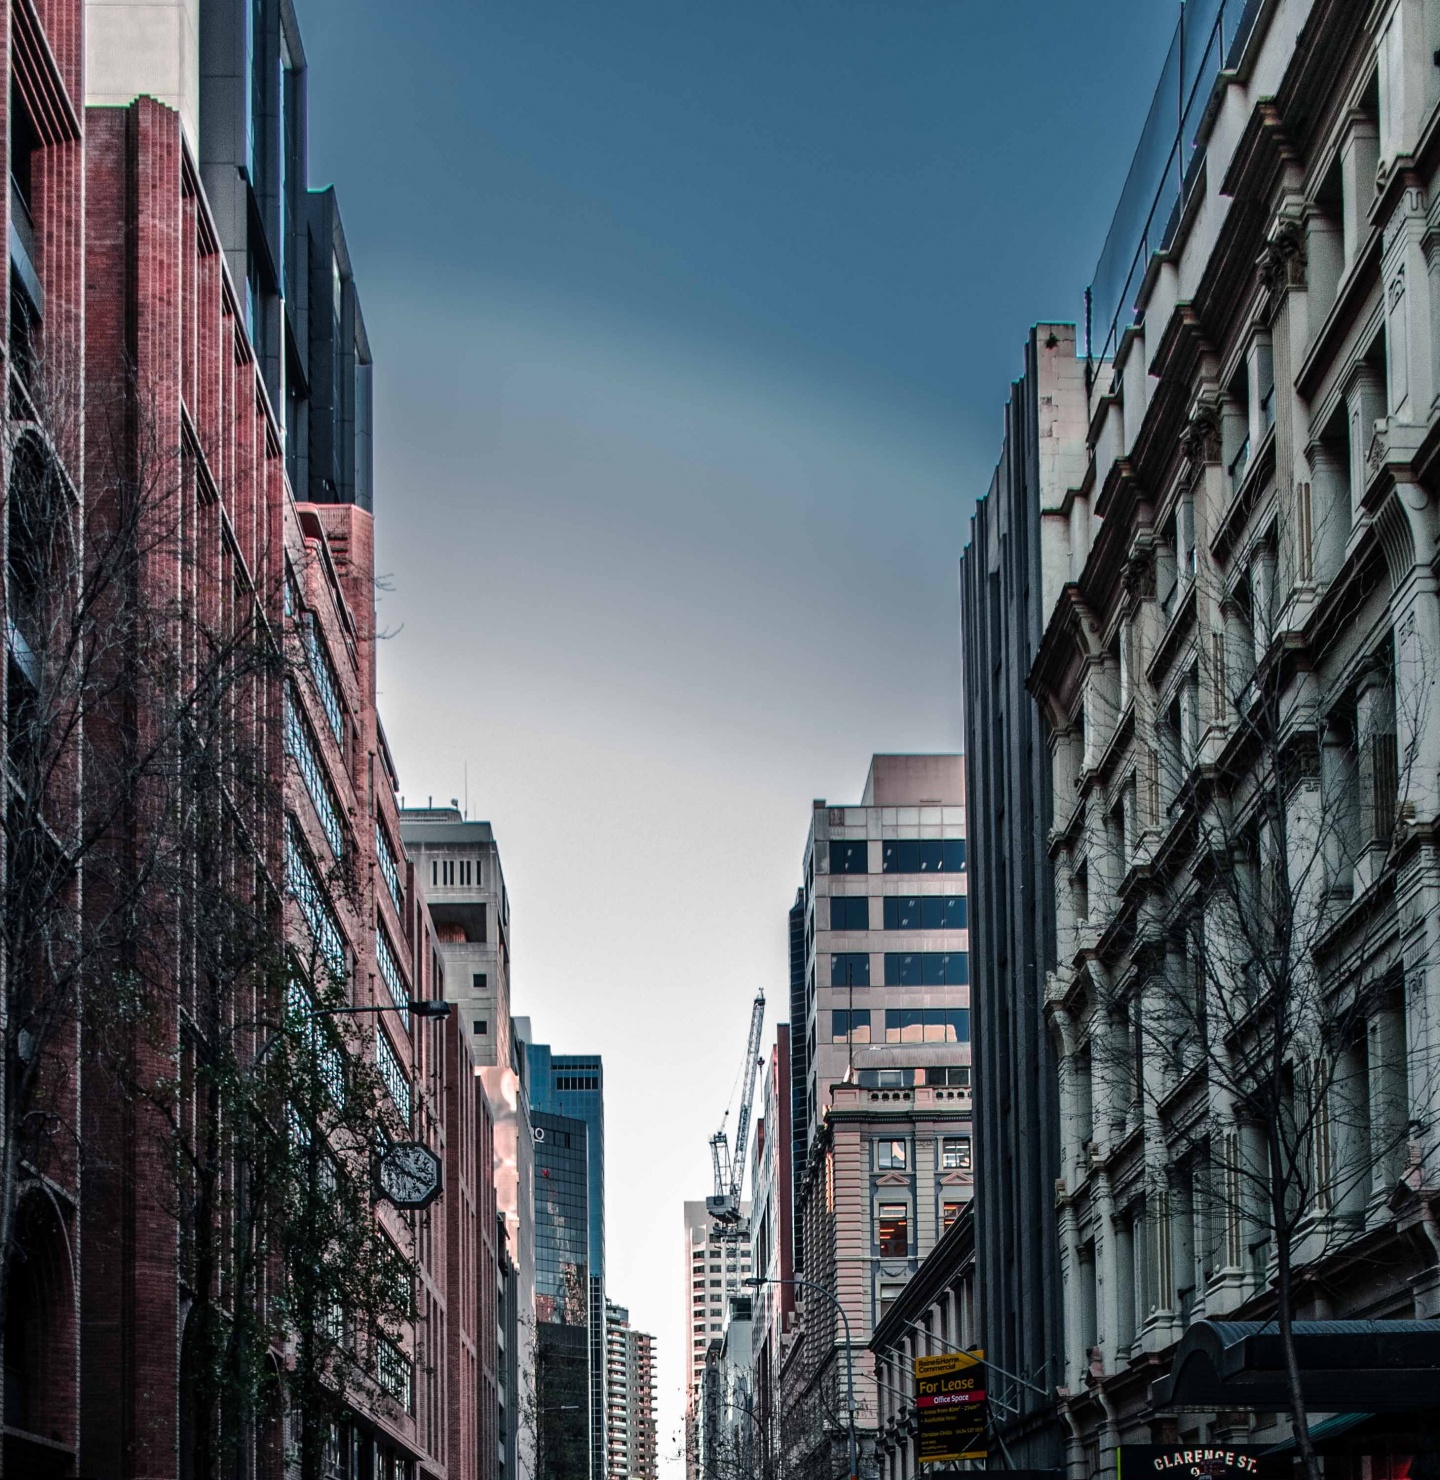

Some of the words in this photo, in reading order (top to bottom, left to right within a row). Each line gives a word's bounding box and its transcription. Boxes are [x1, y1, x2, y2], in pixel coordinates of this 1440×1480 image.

[918, 1357, 959, 1367] Raine&Horne
[918, 1363, 956, 1373] Commercial
[919, 1381, 939, 1394] For
[941, 1378, 974, 1392] Lease
[933, 1396, 951, 1404] Office
[951, 1394, 969, 1403] Space
[1236, 1455, 1258, 1474] ST.
